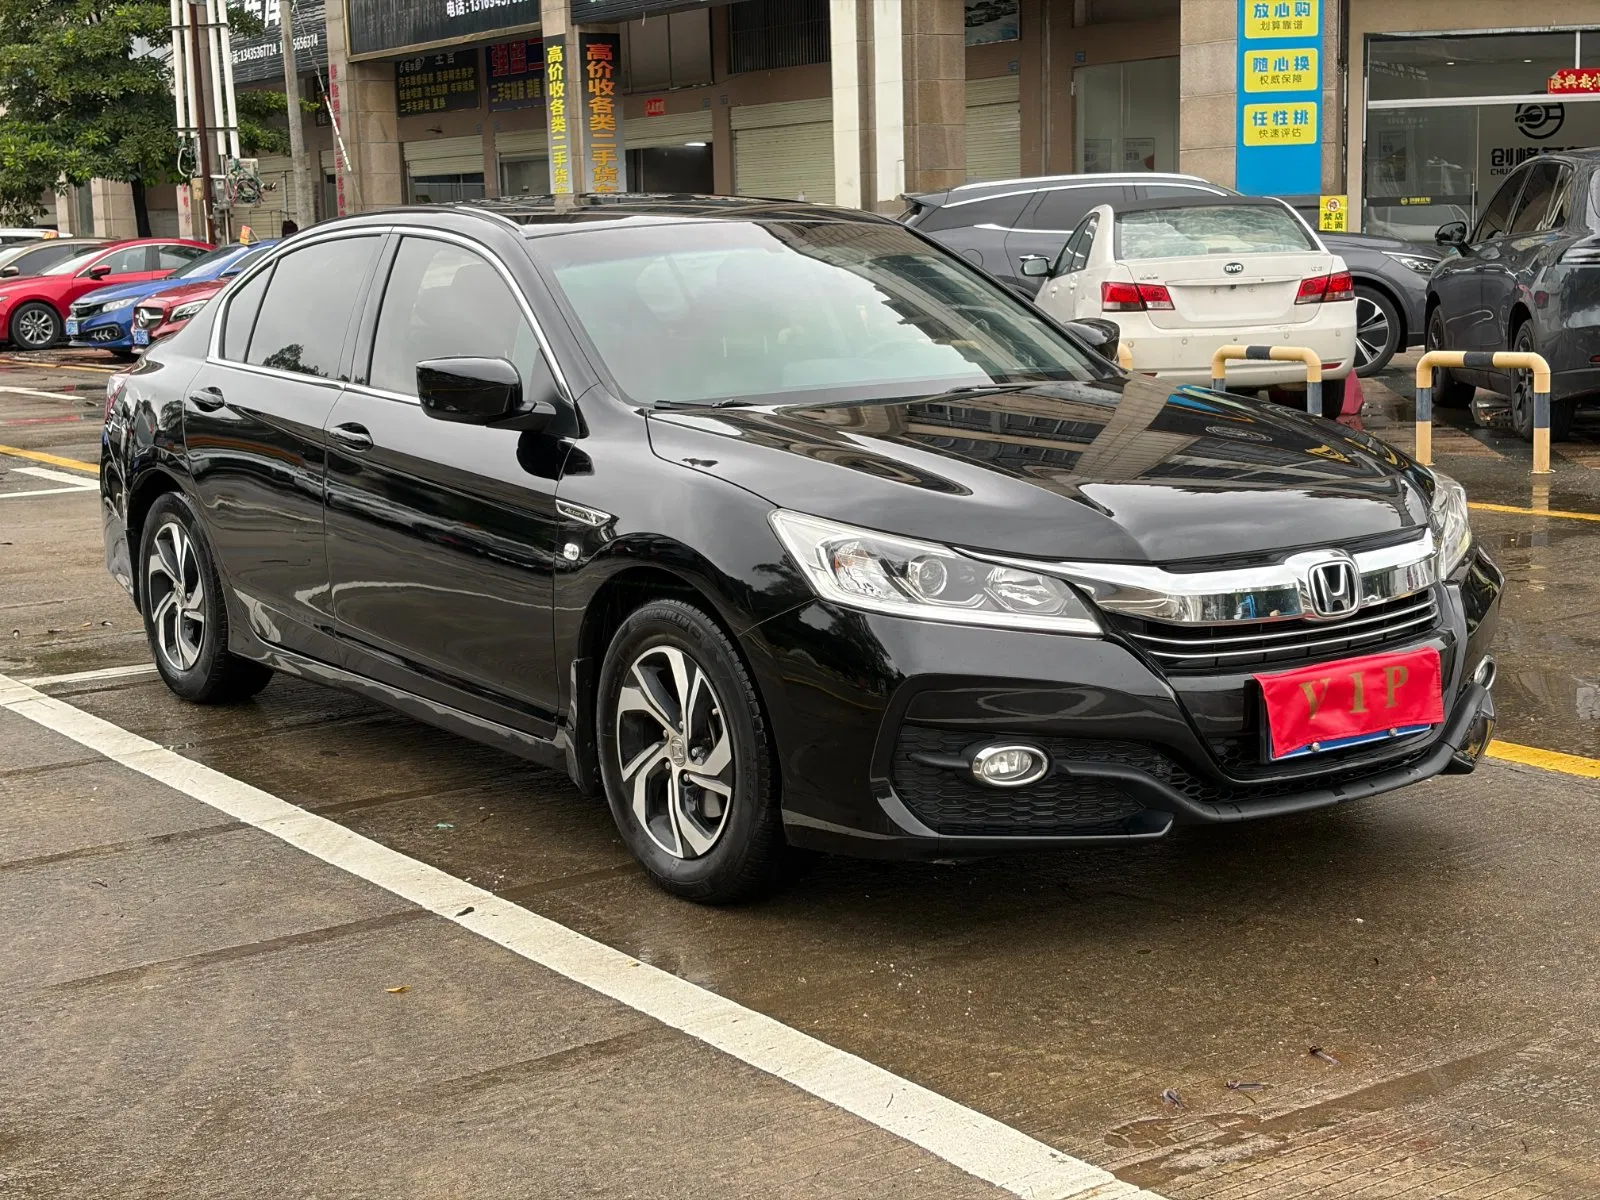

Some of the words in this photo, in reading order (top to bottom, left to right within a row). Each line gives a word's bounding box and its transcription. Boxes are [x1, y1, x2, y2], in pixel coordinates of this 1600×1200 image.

[1253, 2, 1310, 19] 放心购
[1253, 56, 1309, 73] 随心换
[1260, 74, 1302, 85] 权威保障
[1252, 110, 1309, 126] 任性挑
[1258, 128, 1302, 138] 快速评估
[1300, 665, 1409, 720] VIP
